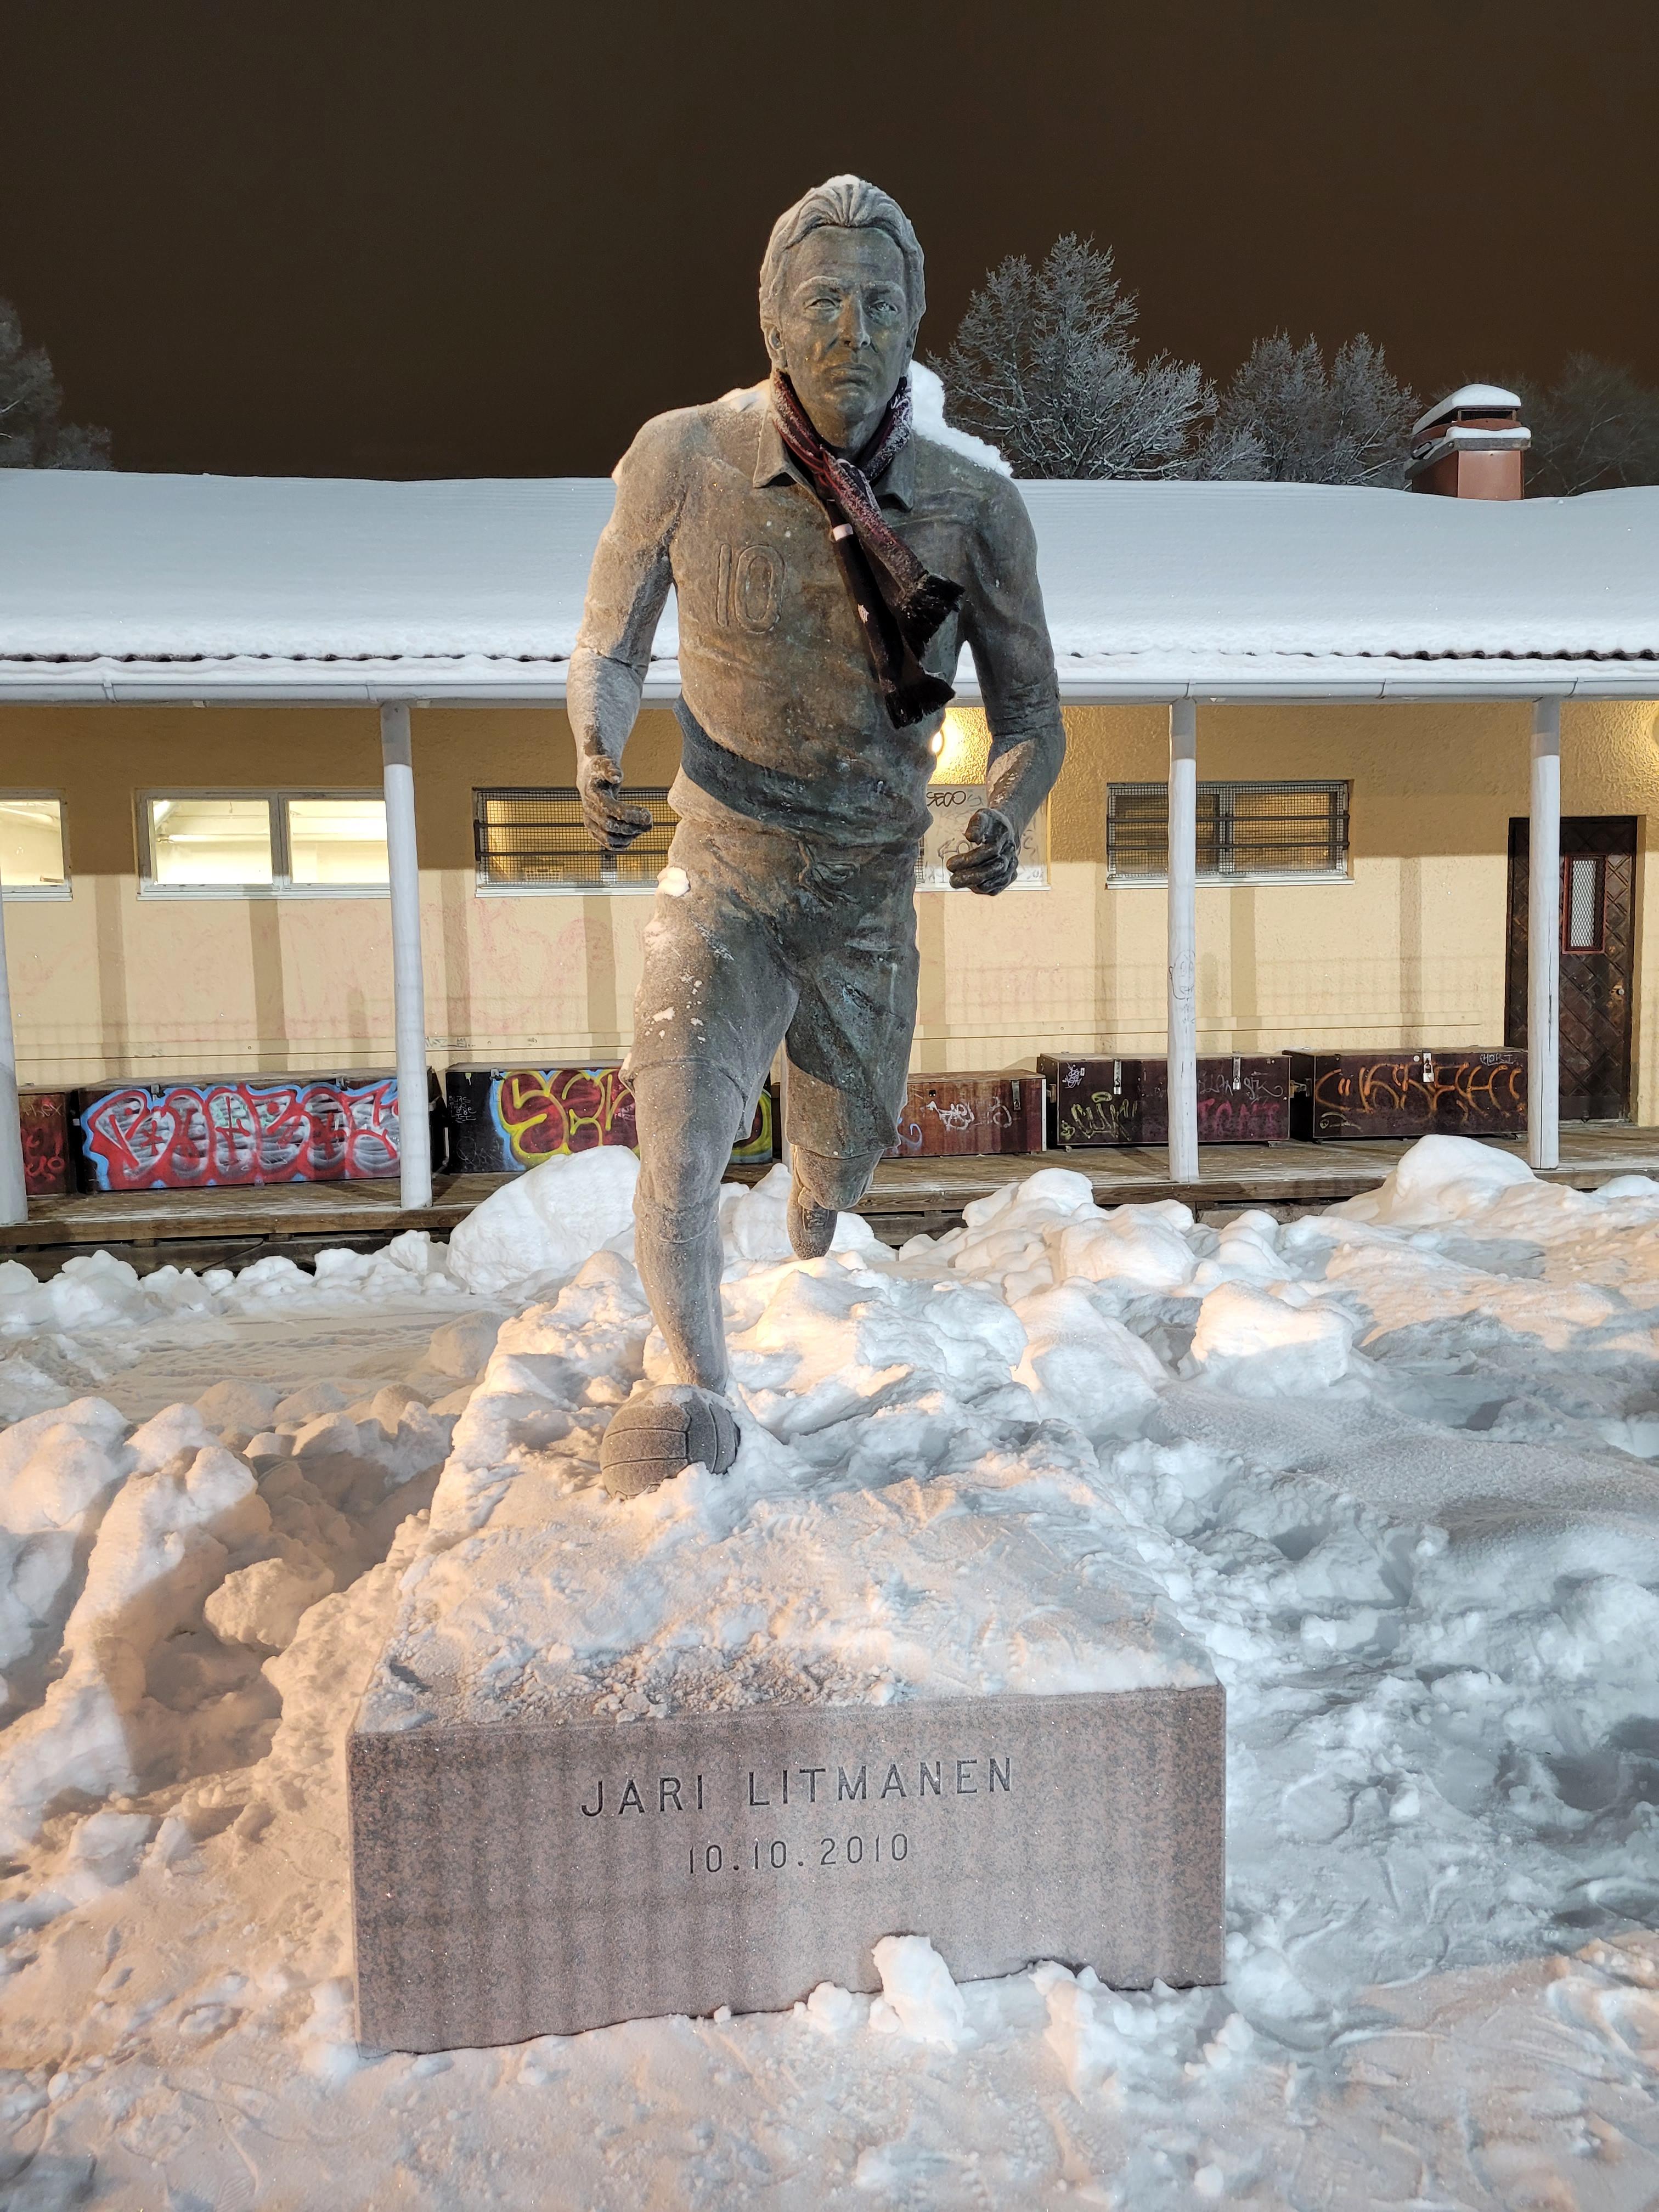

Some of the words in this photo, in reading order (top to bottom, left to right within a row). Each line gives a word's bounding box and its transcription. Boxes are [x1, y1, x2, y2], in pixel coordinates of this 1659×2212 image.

[716, 543, 786, 634] 10
[582, 1774, 703, 1817] JARI
[749, 1758, 1011, 1806] LITMANEN
[690, 1833, 908, 1874] 10.10.2010
